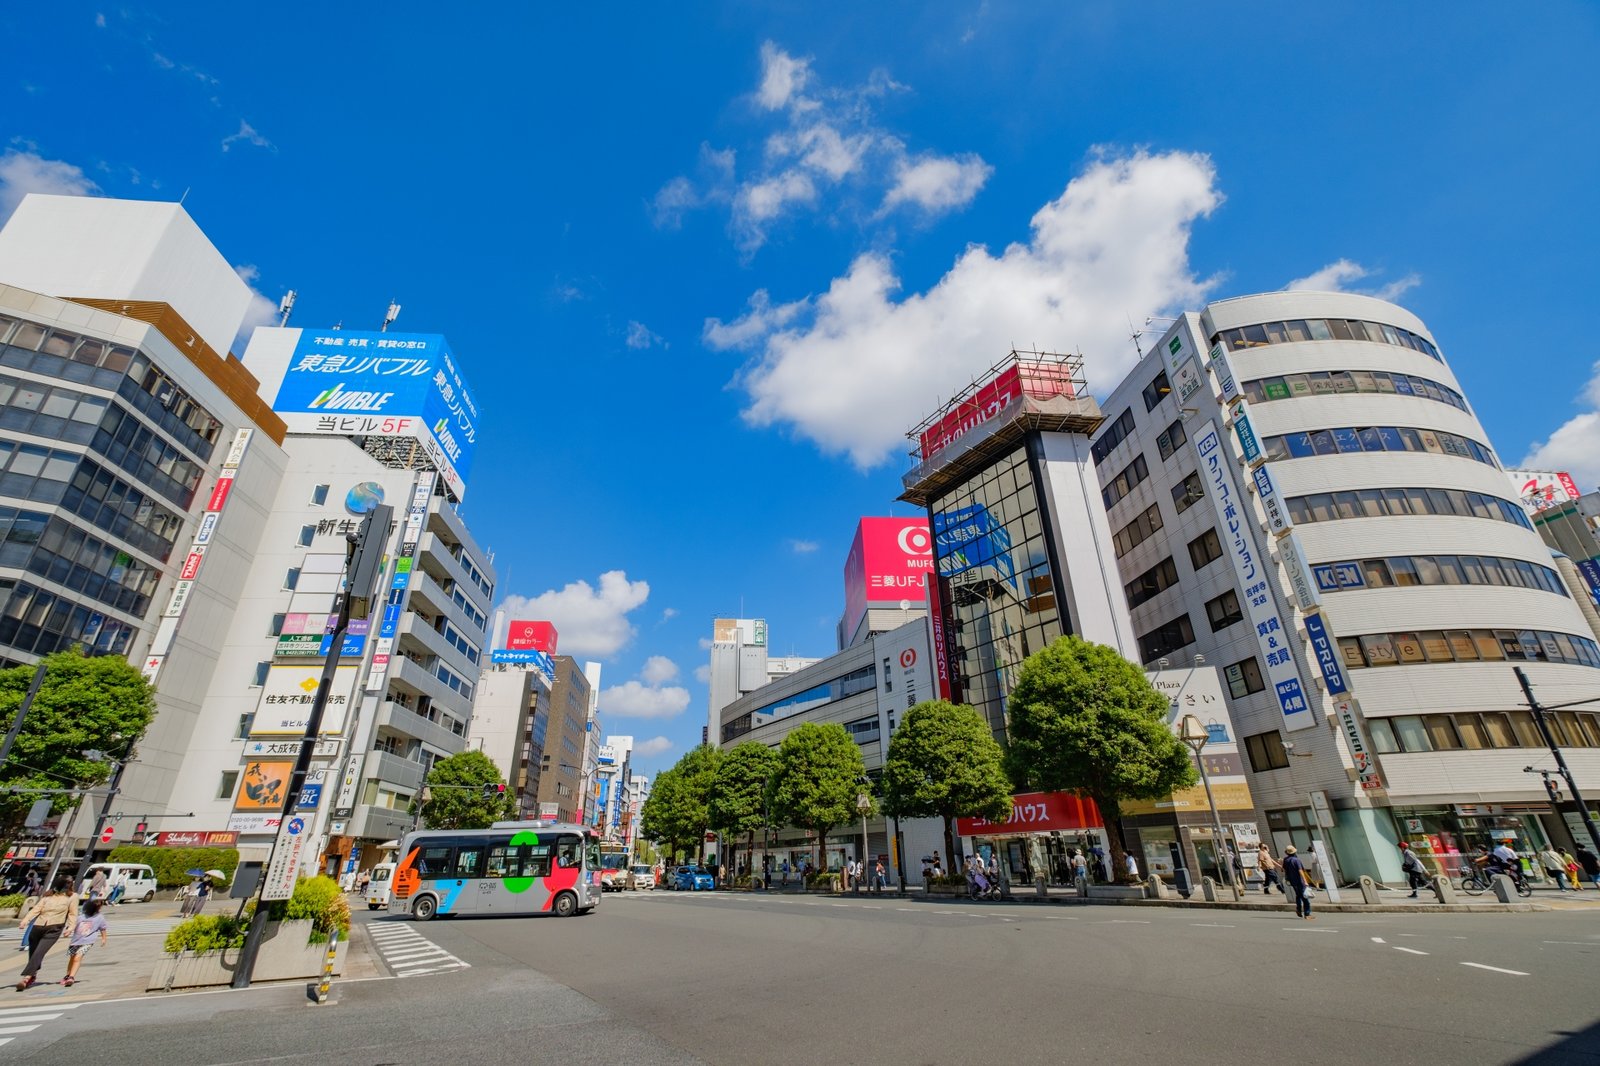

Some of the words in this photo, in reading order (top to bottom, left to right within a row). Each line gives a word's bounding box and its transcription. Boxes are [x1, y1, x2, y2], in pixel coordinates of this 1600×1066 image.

[314, 336, 345, 346] 不動産
[291, 354, 432, 376] 東急リバブル
[433, 369, 475, 444] 東急リバブル
[1208, 453, 1255, 580] ケン・コーポレーション
[871, 575, 925, 587] 三菱UFJ
[1318, 566, 1360, 588] KEN
[1245, 581, 1266, 598] 吉祥寺
[1252, 594, 1267, 607] 支店
[1257, 617, 1280, 637] 賃貸
[934, 616, 947, 680] 三井のリハウス
[1268, 636, 1278, 648] &
[1266, 648, 1291, 667] 売買
[1315, 639, 1340, 687] PREP
[1156, 681, 1181, 690] Plaza
[266, 695, 345, 704] 住友不動販売
[343, 758, 357, 805] ARUHI
[165, 833, 200, 844] Shakey's
[210, 834, 233, 843] PIZZA
